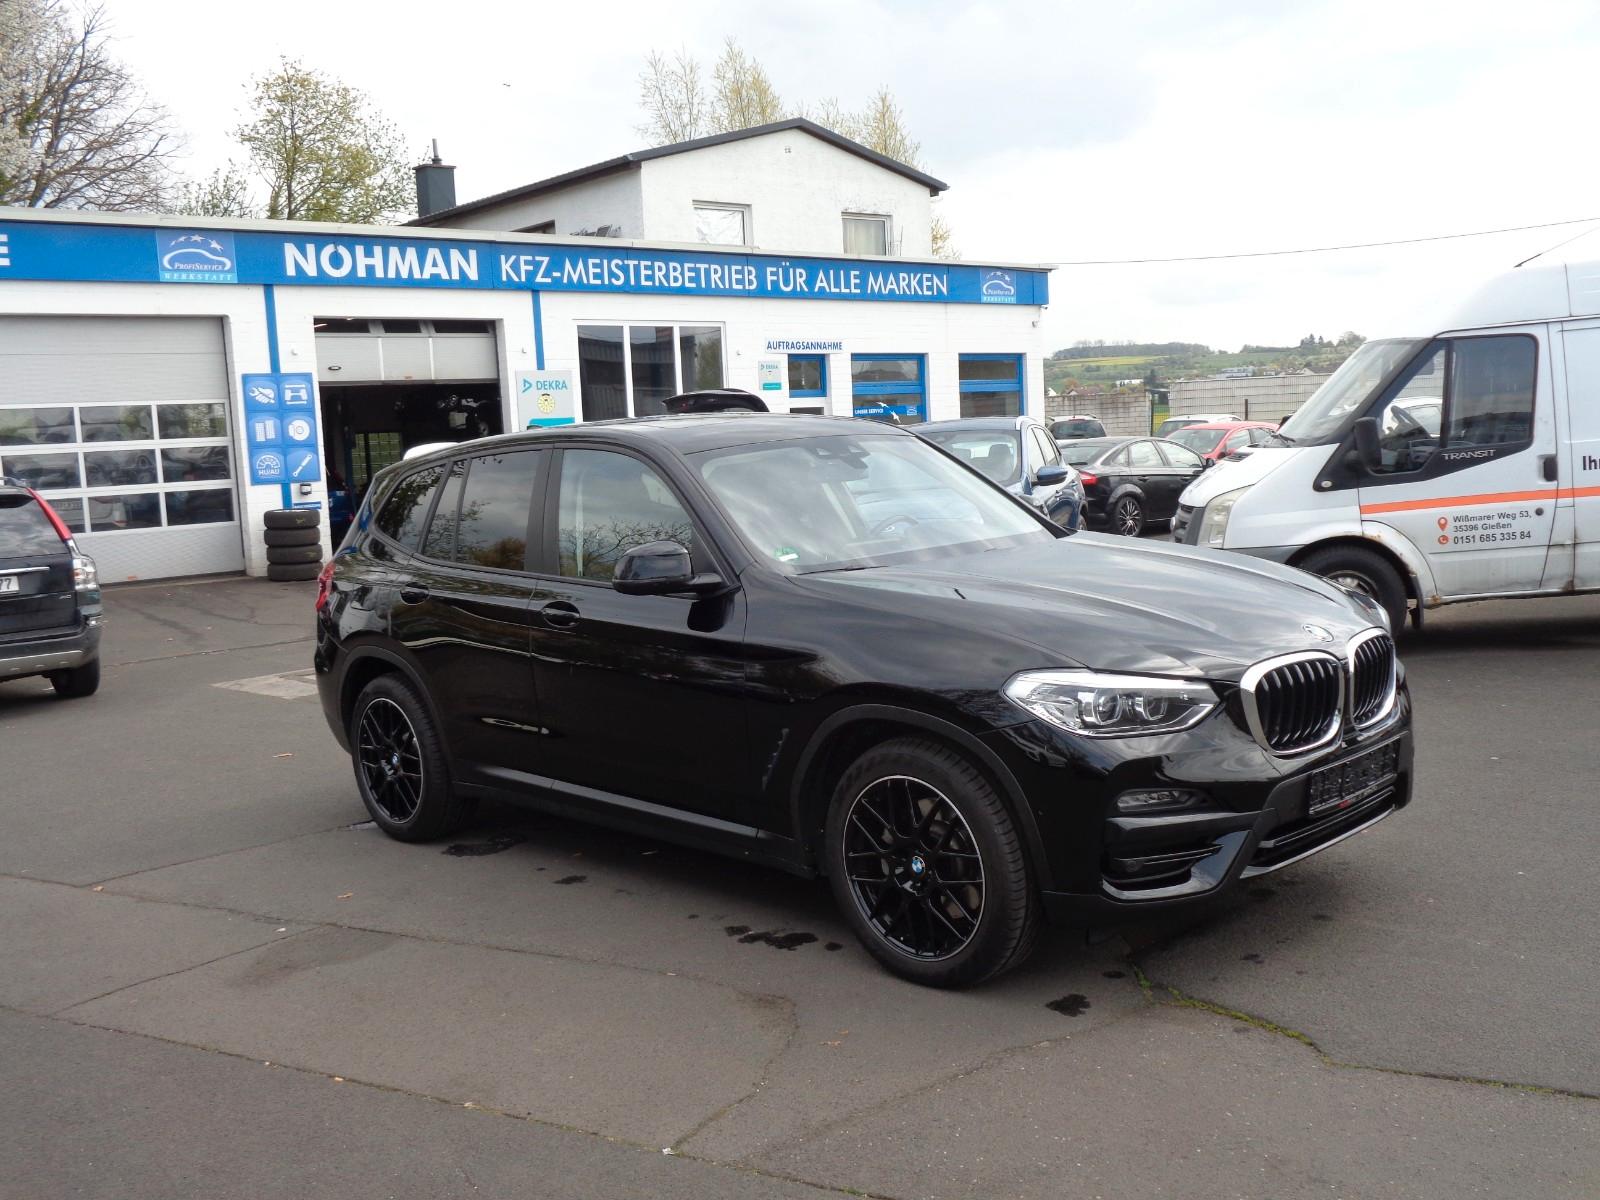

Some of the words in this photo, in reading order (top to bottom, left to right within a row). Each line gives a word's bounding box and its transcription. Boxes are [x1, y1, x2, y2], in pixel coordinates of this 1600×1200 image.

[284, 242, 479, 281] NOHMAN
[500, 254, 758, 289] KFZ-MEISTERBETRIEB
[767, 262, 807, 293] FÜR
[815, 269, 861, 295] ALLE
[867, 271, 948, 297] MARKEN
[766, 340, 843, 351] AUFTRAGSANNAHME
[535, 380, 568, 391] DEKRA
[1442, 450, 1496, 460] TRANSIT
[1582, 455, 1600, 471] Ih
[1453, 514, 1496, 523] Wißmarer
[1497, 511, 1517, 520] Weg
[1519, 510, 1532, 519] 53,
[1453, 524, 1479, 533] 35396
[1481, 522, 1512, 531] Gießen
[1453, 534, 1476, 545] 0151
[1479, 533, 1497, 543] 685
[1500, 531, 1517, 541] 335
[1519, 530, 1531, 540] 84
